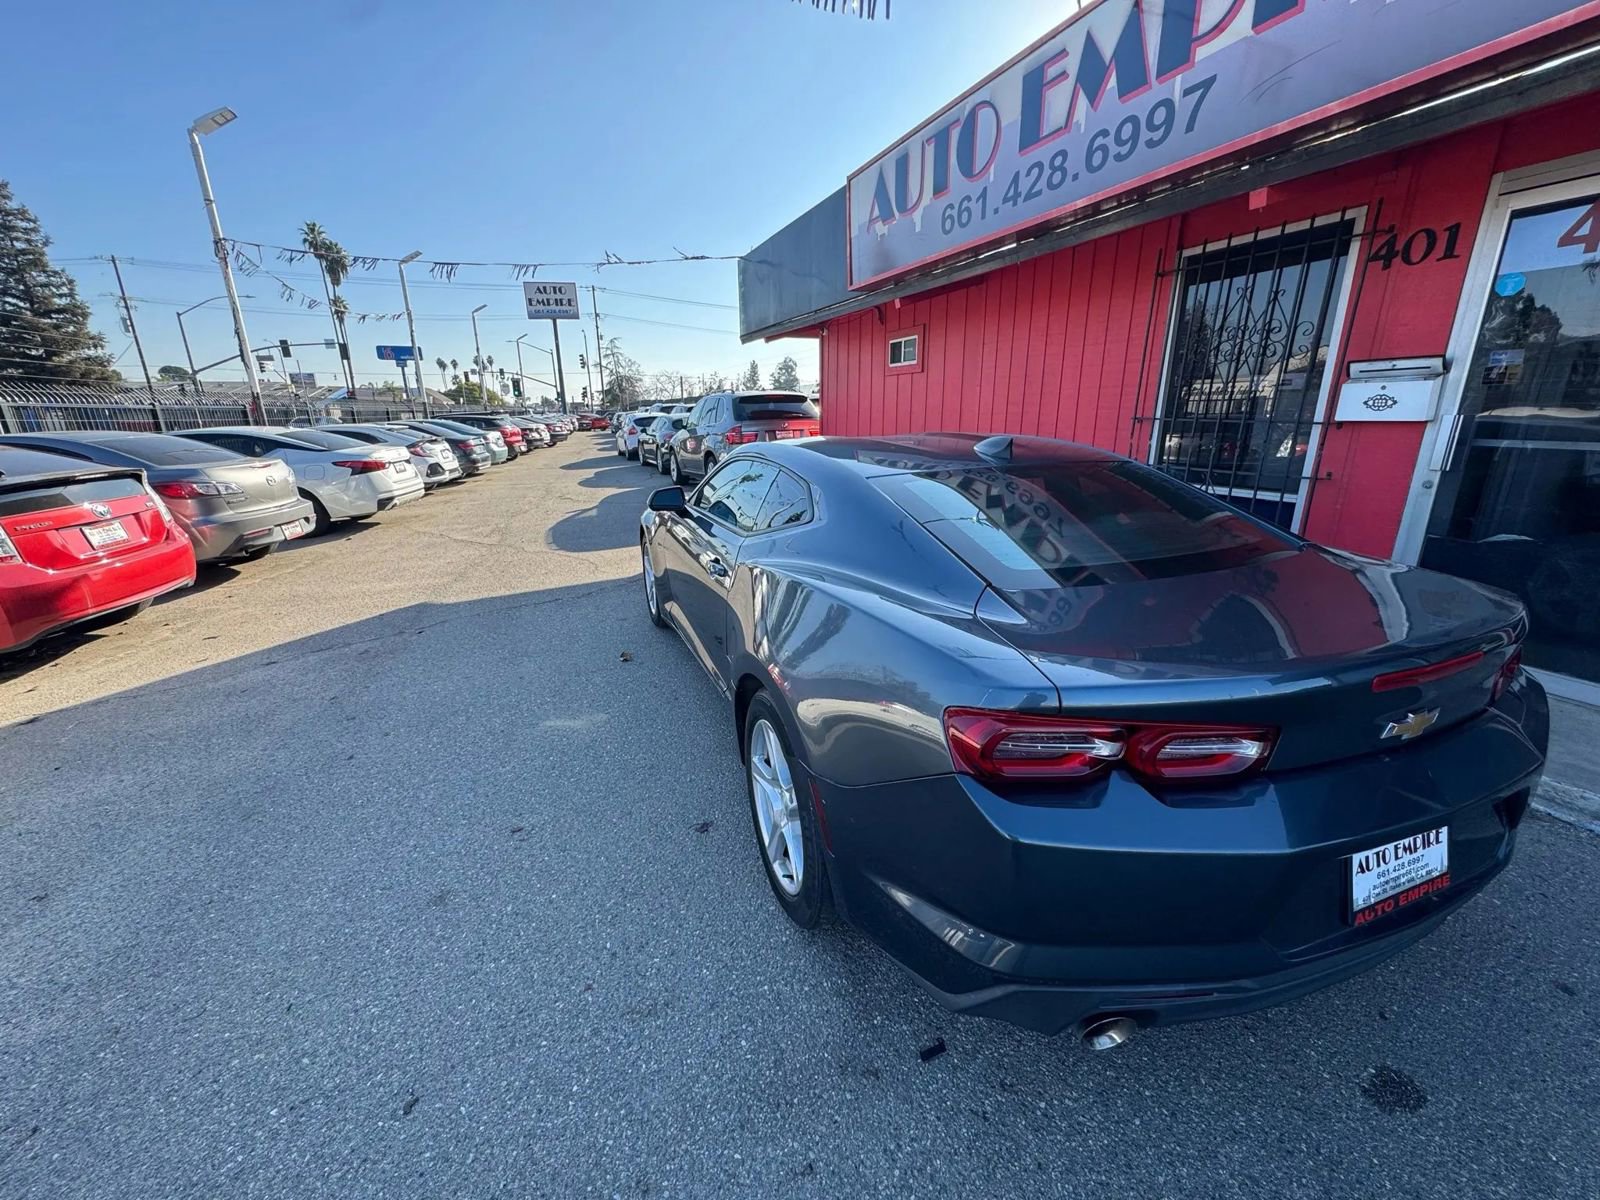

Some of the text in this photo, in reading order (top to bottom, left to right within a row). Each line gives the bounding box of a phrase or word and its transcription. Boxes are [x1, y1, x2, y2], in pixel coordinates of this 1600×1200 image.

[867, 100, 1002, 231] AUTO
[940, 73, 1218, 236] 661.428.6997
[1368, 222, 1462, 271] 401
[528, 297, 576, 307] EMPIRE
[535, 285, 567, 295] AUTO
[1356, 829, 1443, 876] AUTO EMPIRE
[1376, 854, 1425, 880] 661.428.6997
[1355, 875, 1450, 926] AUTO EMPIRE
